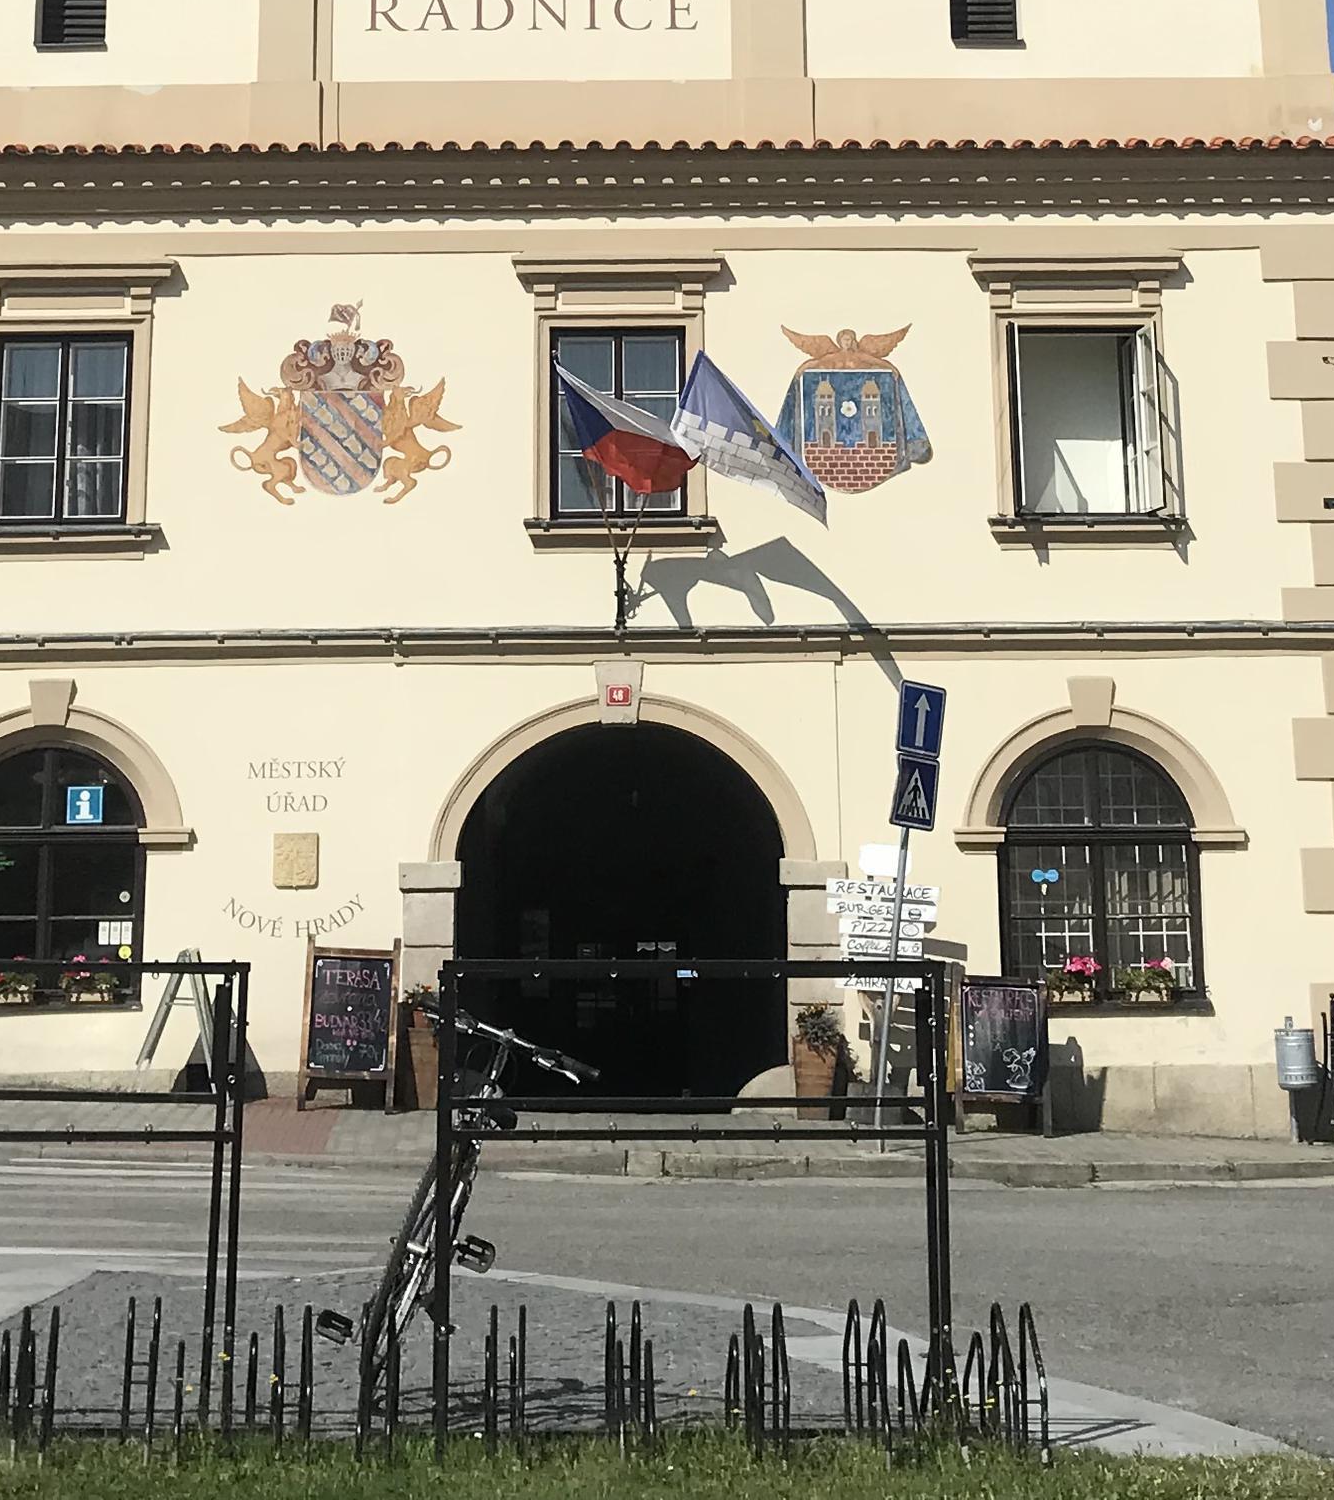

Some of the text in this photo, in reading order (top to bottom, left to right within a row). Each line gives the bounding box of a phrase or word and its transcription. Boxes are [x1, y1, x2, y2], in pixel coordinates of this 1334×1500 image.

[247, 757, 346, 779] MĚSTSKÝ
[267, 791, 328, 812] ÚŘAD
[836, 881, 932, 899] RESTAUACE
[222, 893, 365, 938] NOVÉ HRADY
[323, 970, 381, 990] TERASA
